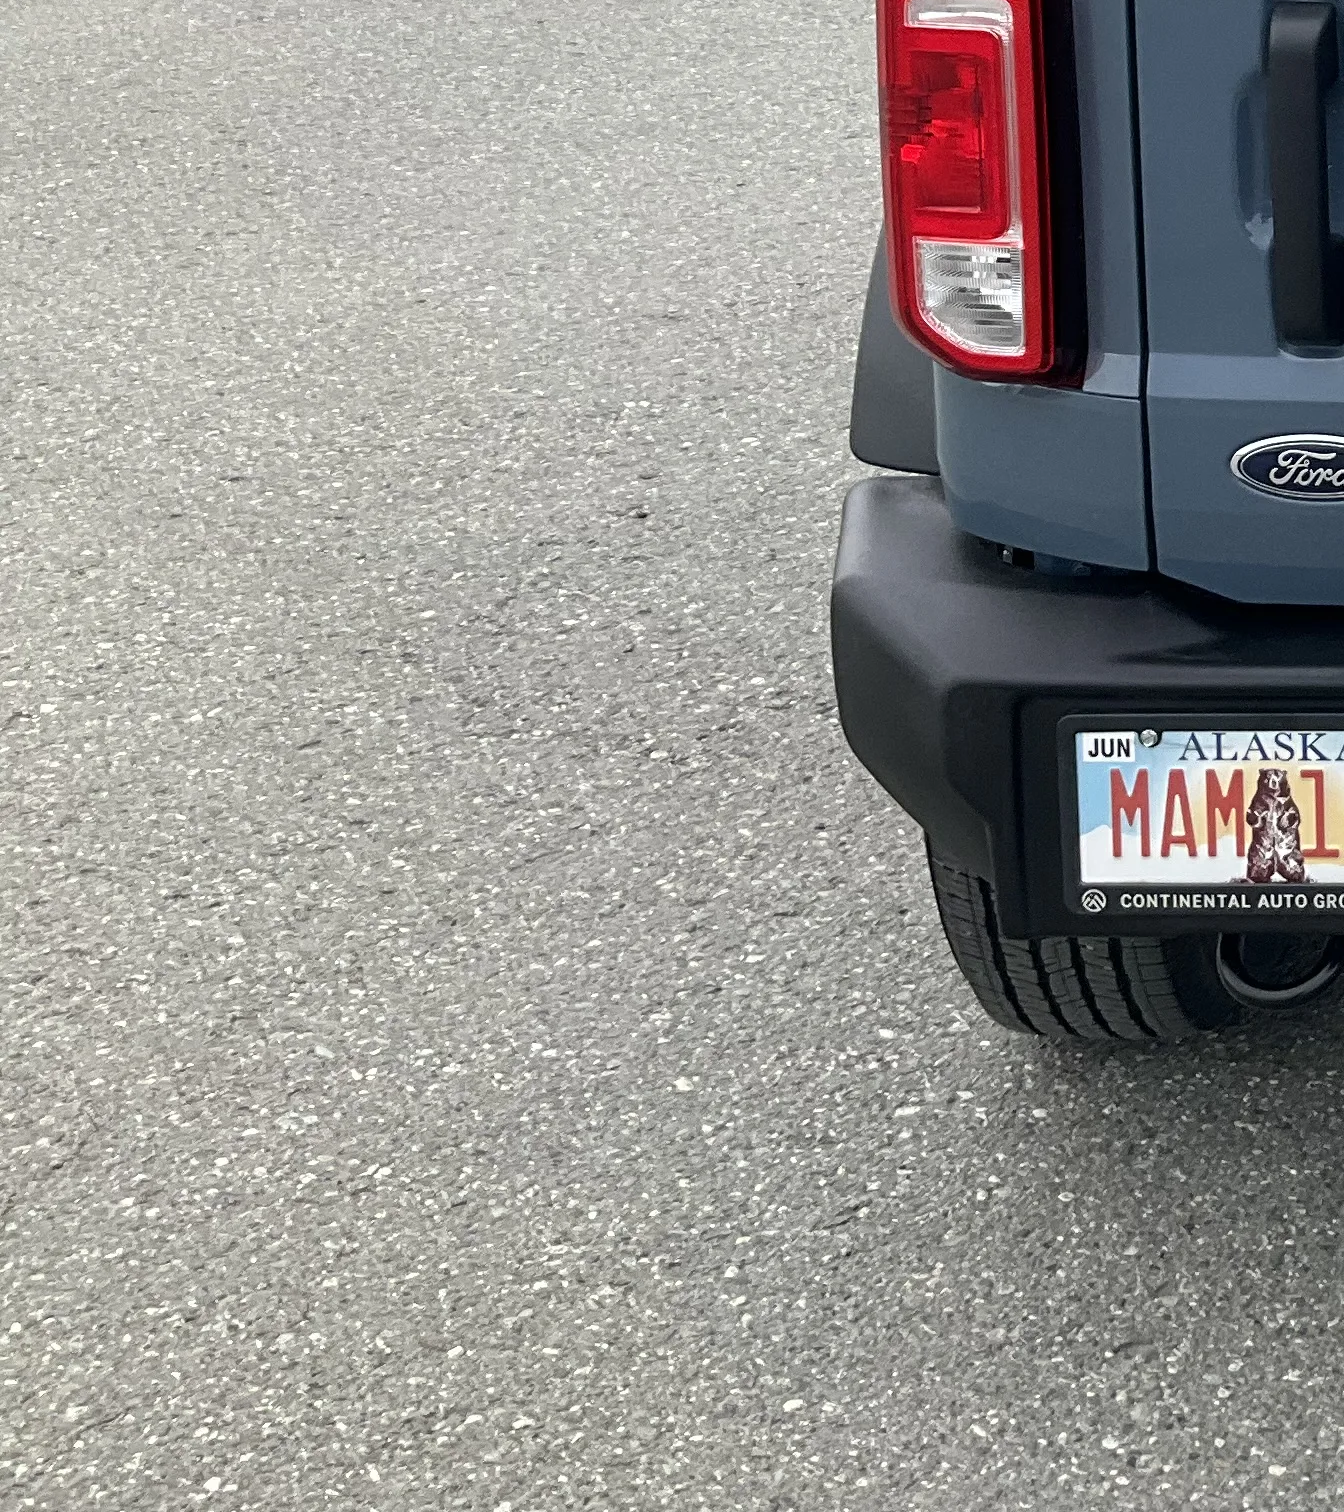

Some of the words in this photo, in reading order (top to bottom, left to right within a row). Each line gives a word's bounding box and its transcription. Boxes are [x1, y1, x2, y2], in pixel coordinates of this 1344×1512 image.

[1088, 738, 1131, 758] JUN
[1110, 768, 1246, 858] MAM
[1120, 893, 1251, 909] CONTINENTAL
[1257, 894, 1308, 909] AUTO
